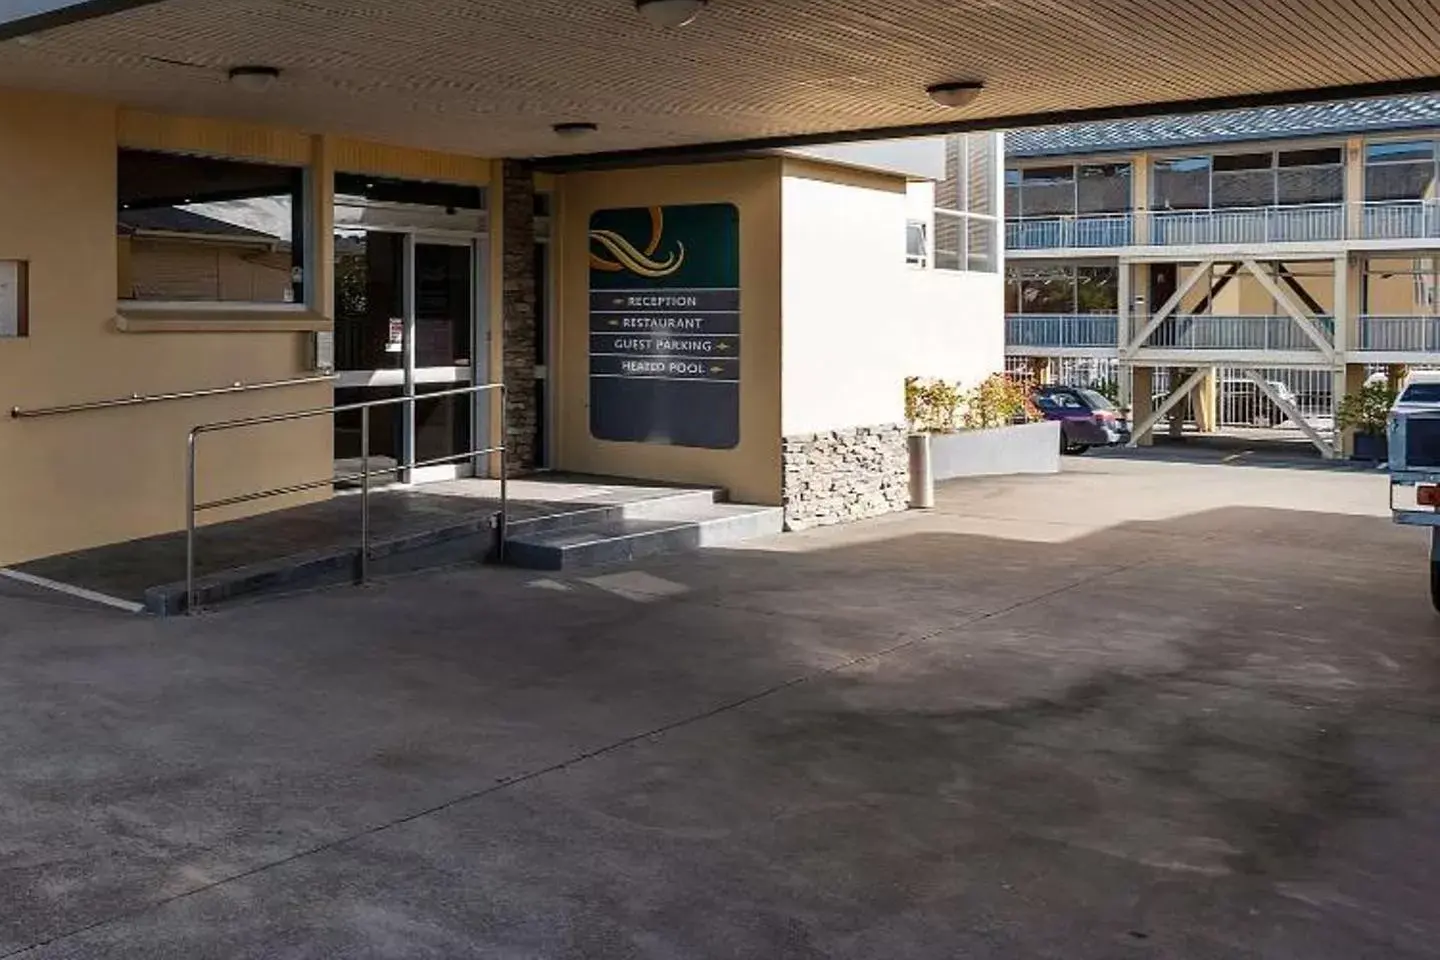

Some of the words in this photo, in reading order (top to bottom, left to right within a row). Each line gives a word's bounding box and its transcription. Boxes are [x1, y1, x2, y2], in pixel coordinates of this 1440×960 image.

[627, 296, 697, 307] RECEPTION
[623, 317, 703, 329] RESTAURANT
[614, 339, 652, 350] GUEST
[656, 340, 712, 352] PARKING
[622, 361, 665, 372] HEATED
[669, 363, 706, 374] POOL
